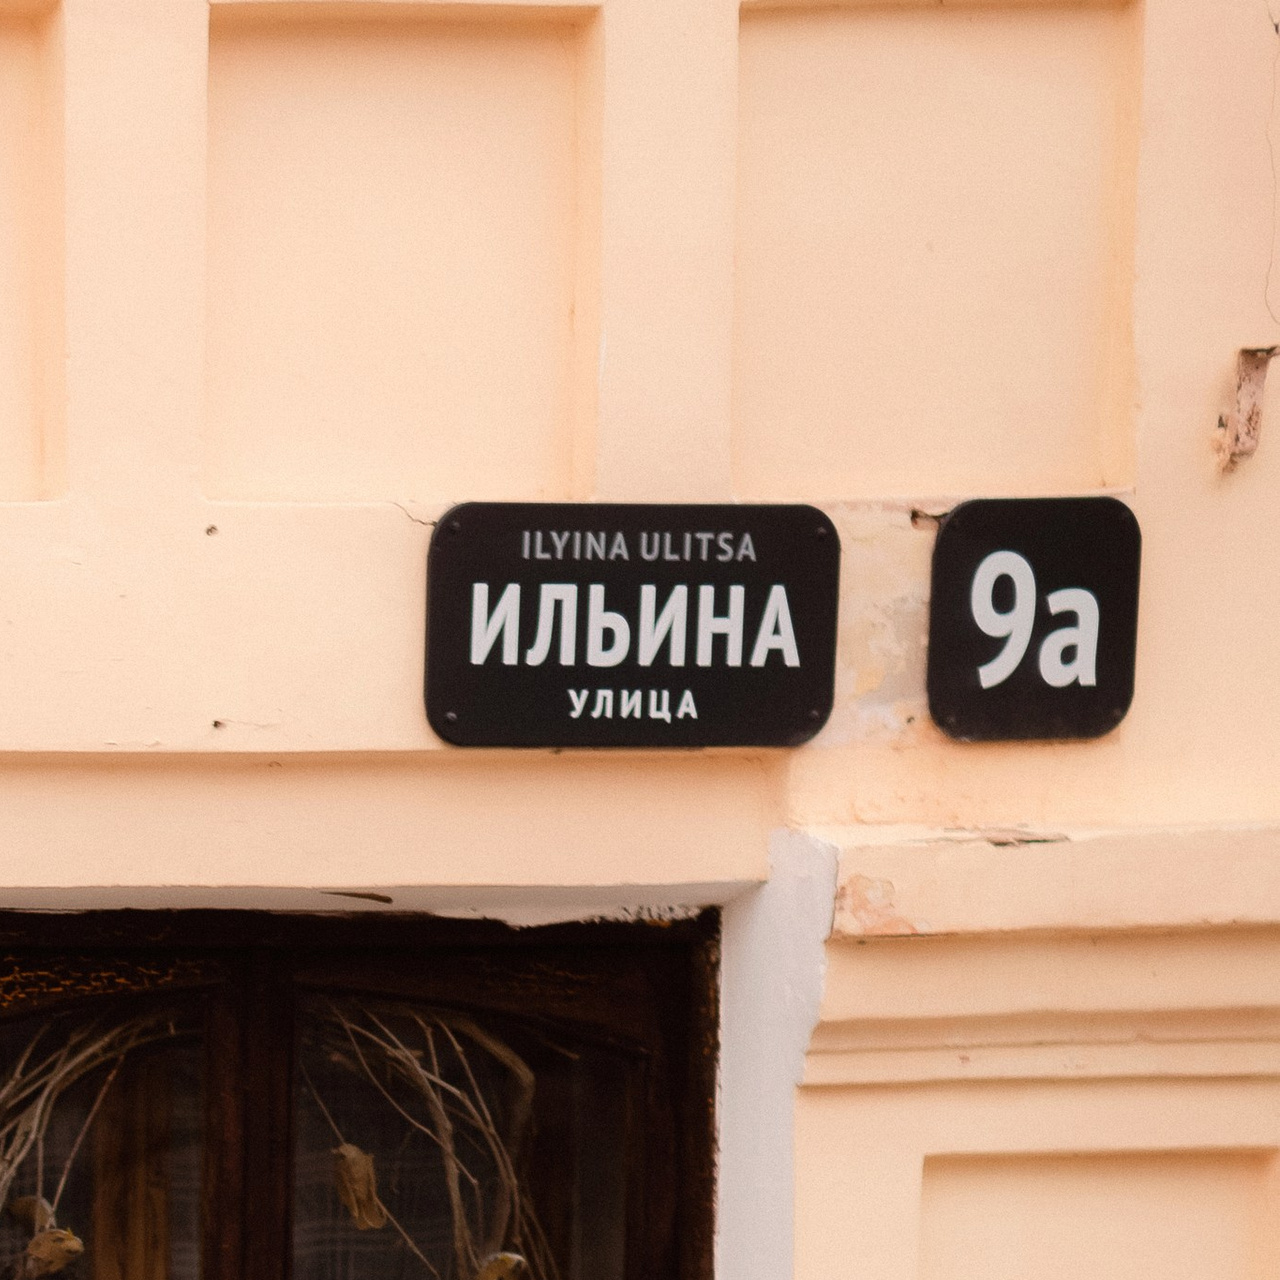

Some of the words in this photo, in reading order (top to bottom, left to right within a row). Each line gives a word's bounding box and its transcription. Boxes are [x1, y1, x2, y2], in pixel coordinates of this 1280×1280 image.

[521, 530, 629, 561] ILYINA
[639, 530, 757, 562] ULITSA
[469, 582, 801, 668] ИЛЬИНА
[567, 688, 698, 724] УЛИЦА
